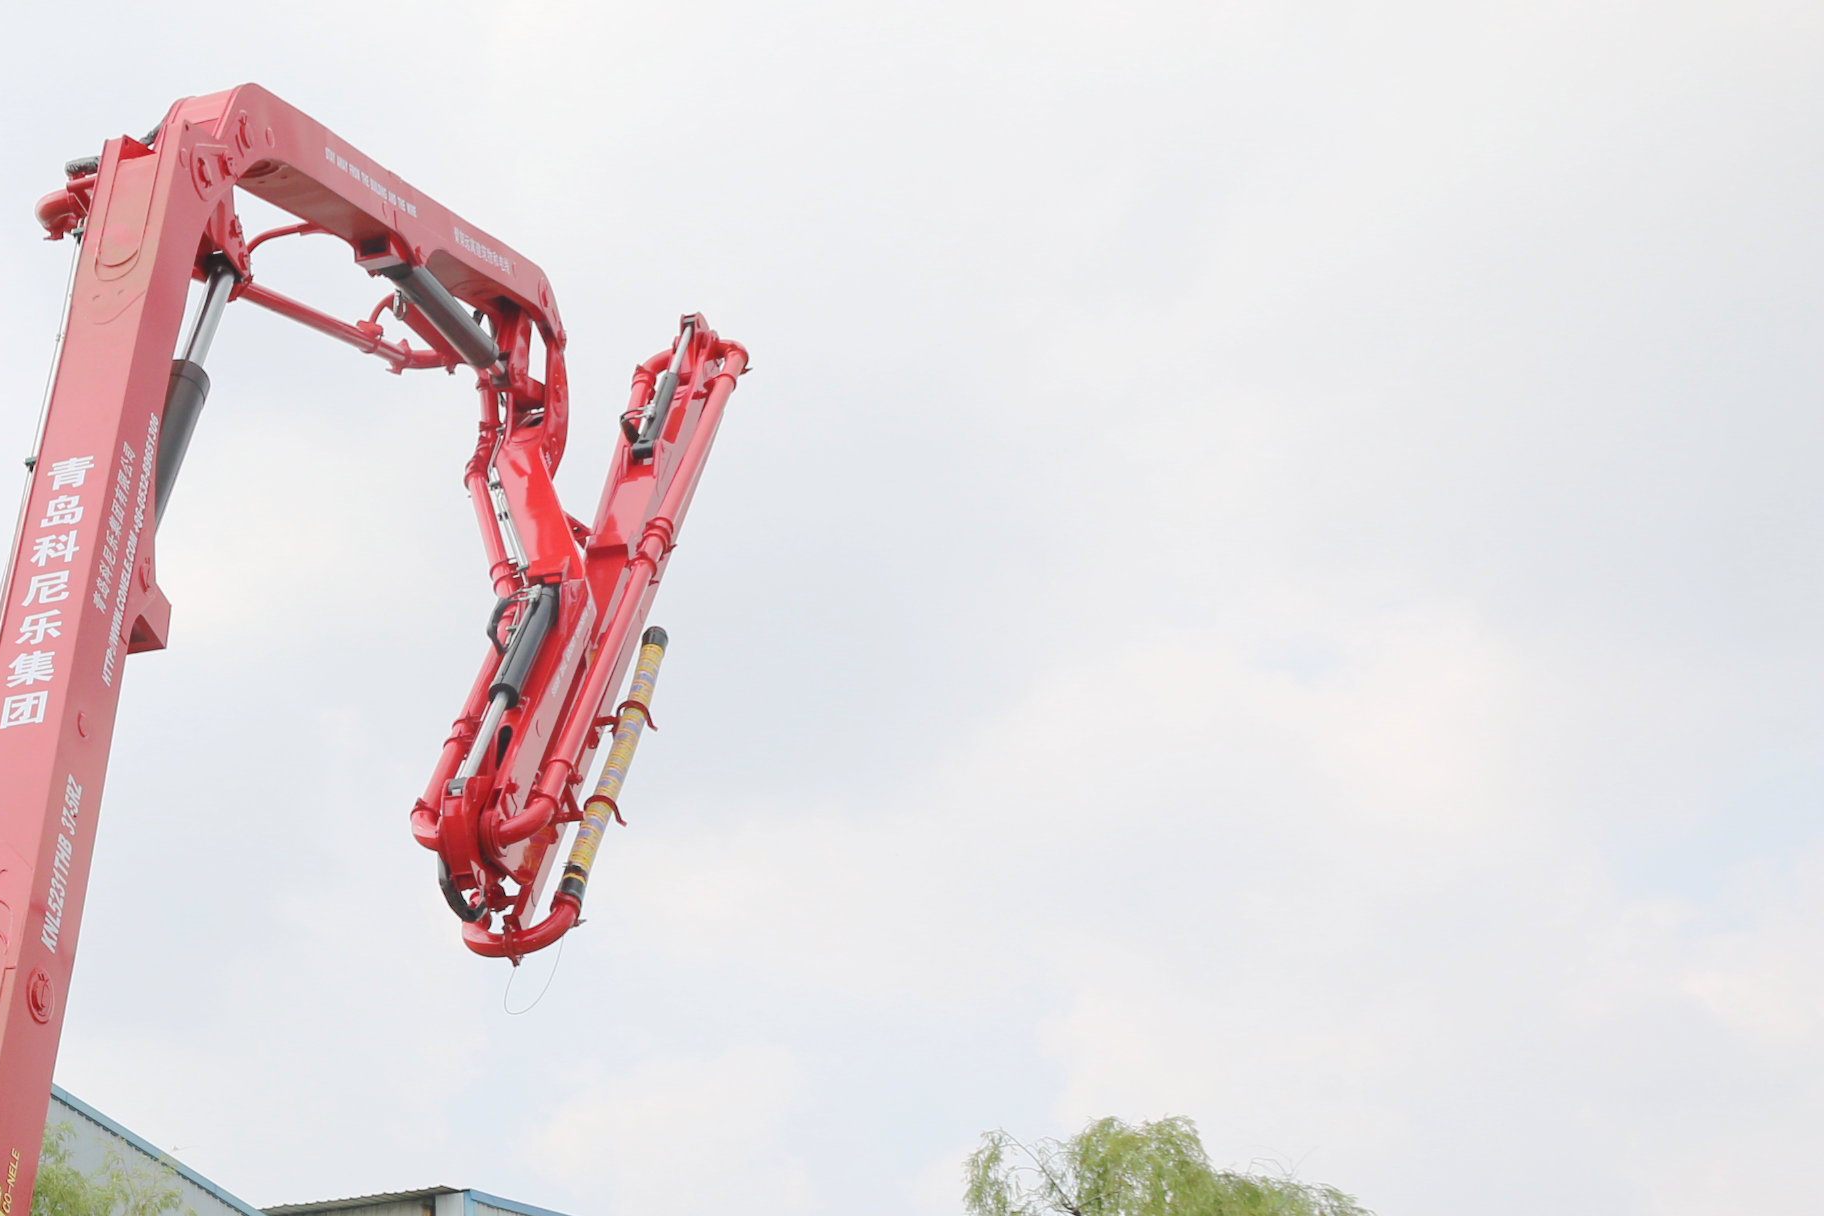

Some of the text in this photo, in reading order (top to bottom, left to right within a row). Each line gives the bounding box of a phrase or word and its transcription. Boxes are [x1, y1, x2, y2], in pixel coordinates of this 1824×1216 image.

[0, 455, 95, 729] 青岛科尼乐集团
[92, 441, 136, 614] 青岛科尼乐集团有限公司
[41, 833, 73, 954] KNL5231THB
[2, 1148, 20, 1213] CO-NELE
